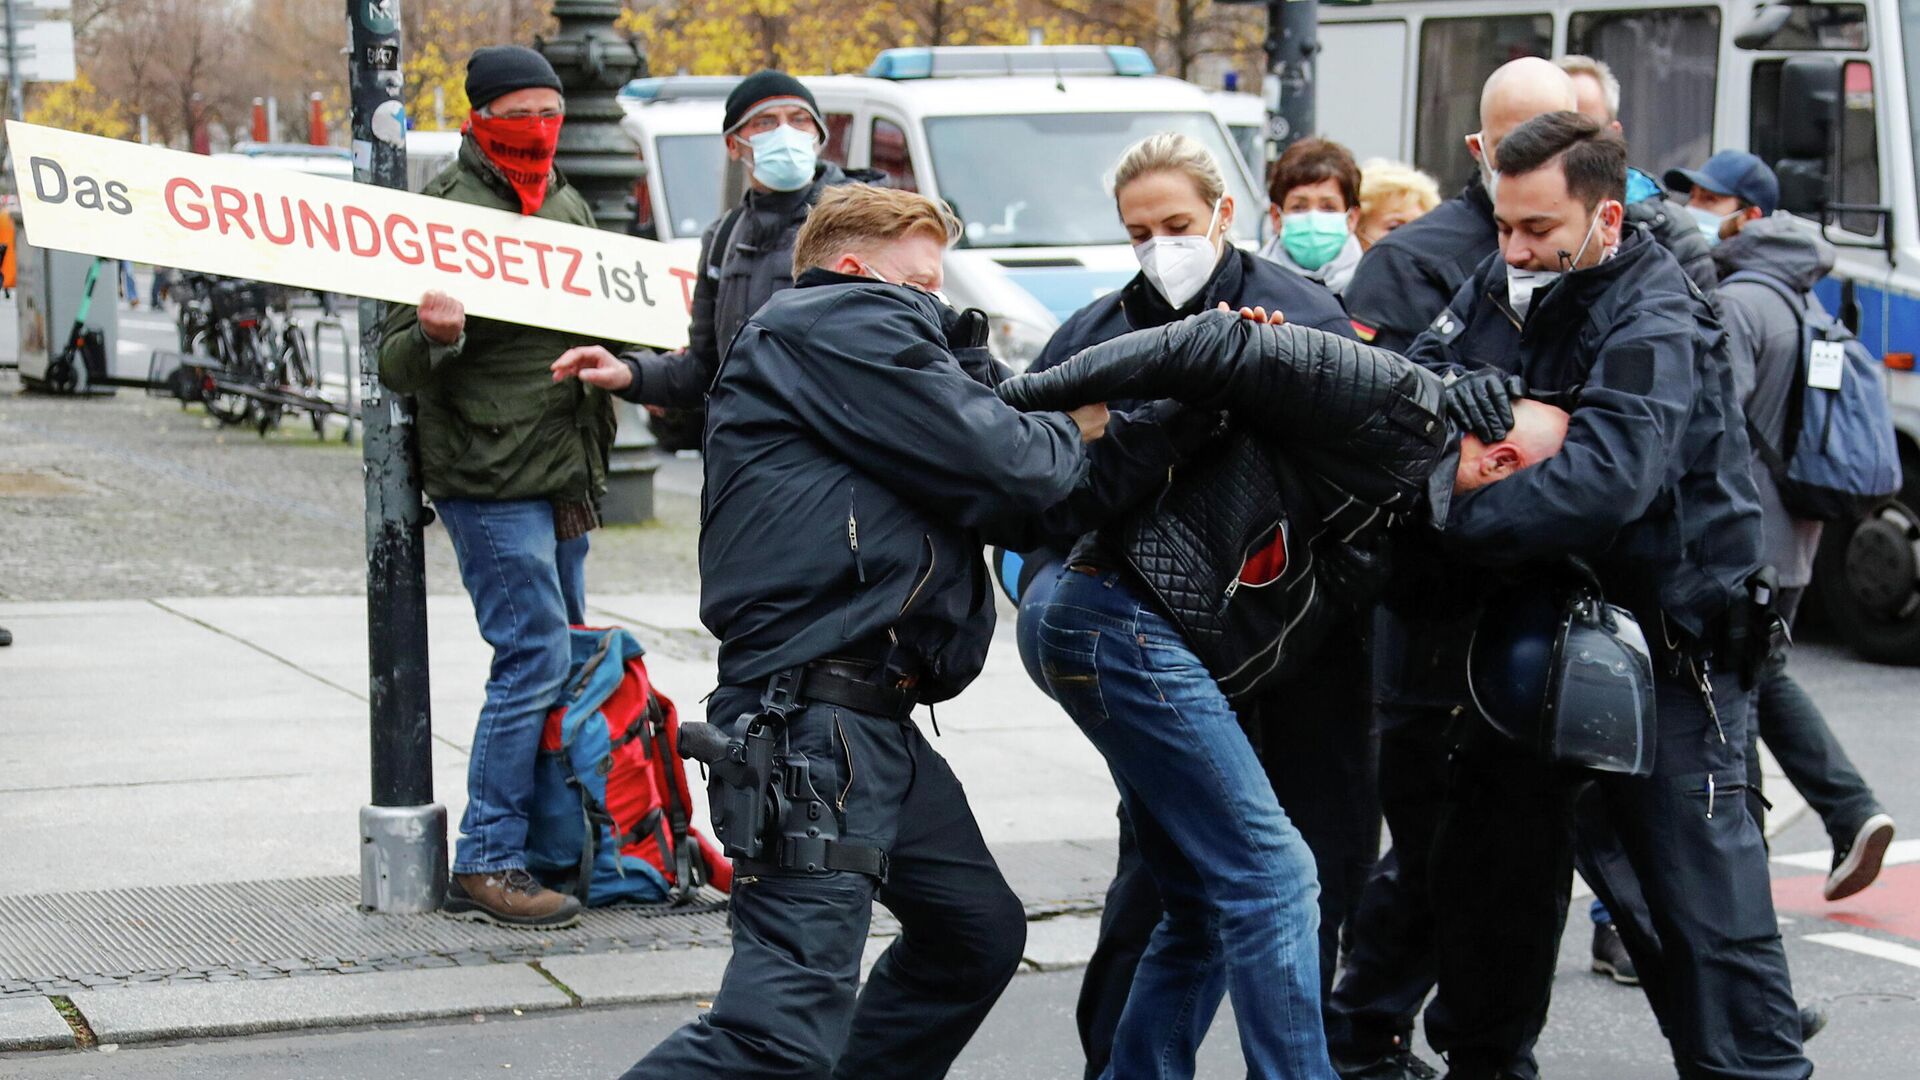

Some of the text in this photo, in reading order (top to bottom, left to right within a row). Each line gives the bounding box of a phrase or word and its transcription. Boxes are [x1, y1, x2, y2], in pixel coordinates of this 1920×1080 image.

[29, 156, 133, 216] Das
[165, 177, 592, 297] GRUNDGESETZ
[596, 251, 656, 307] ist
